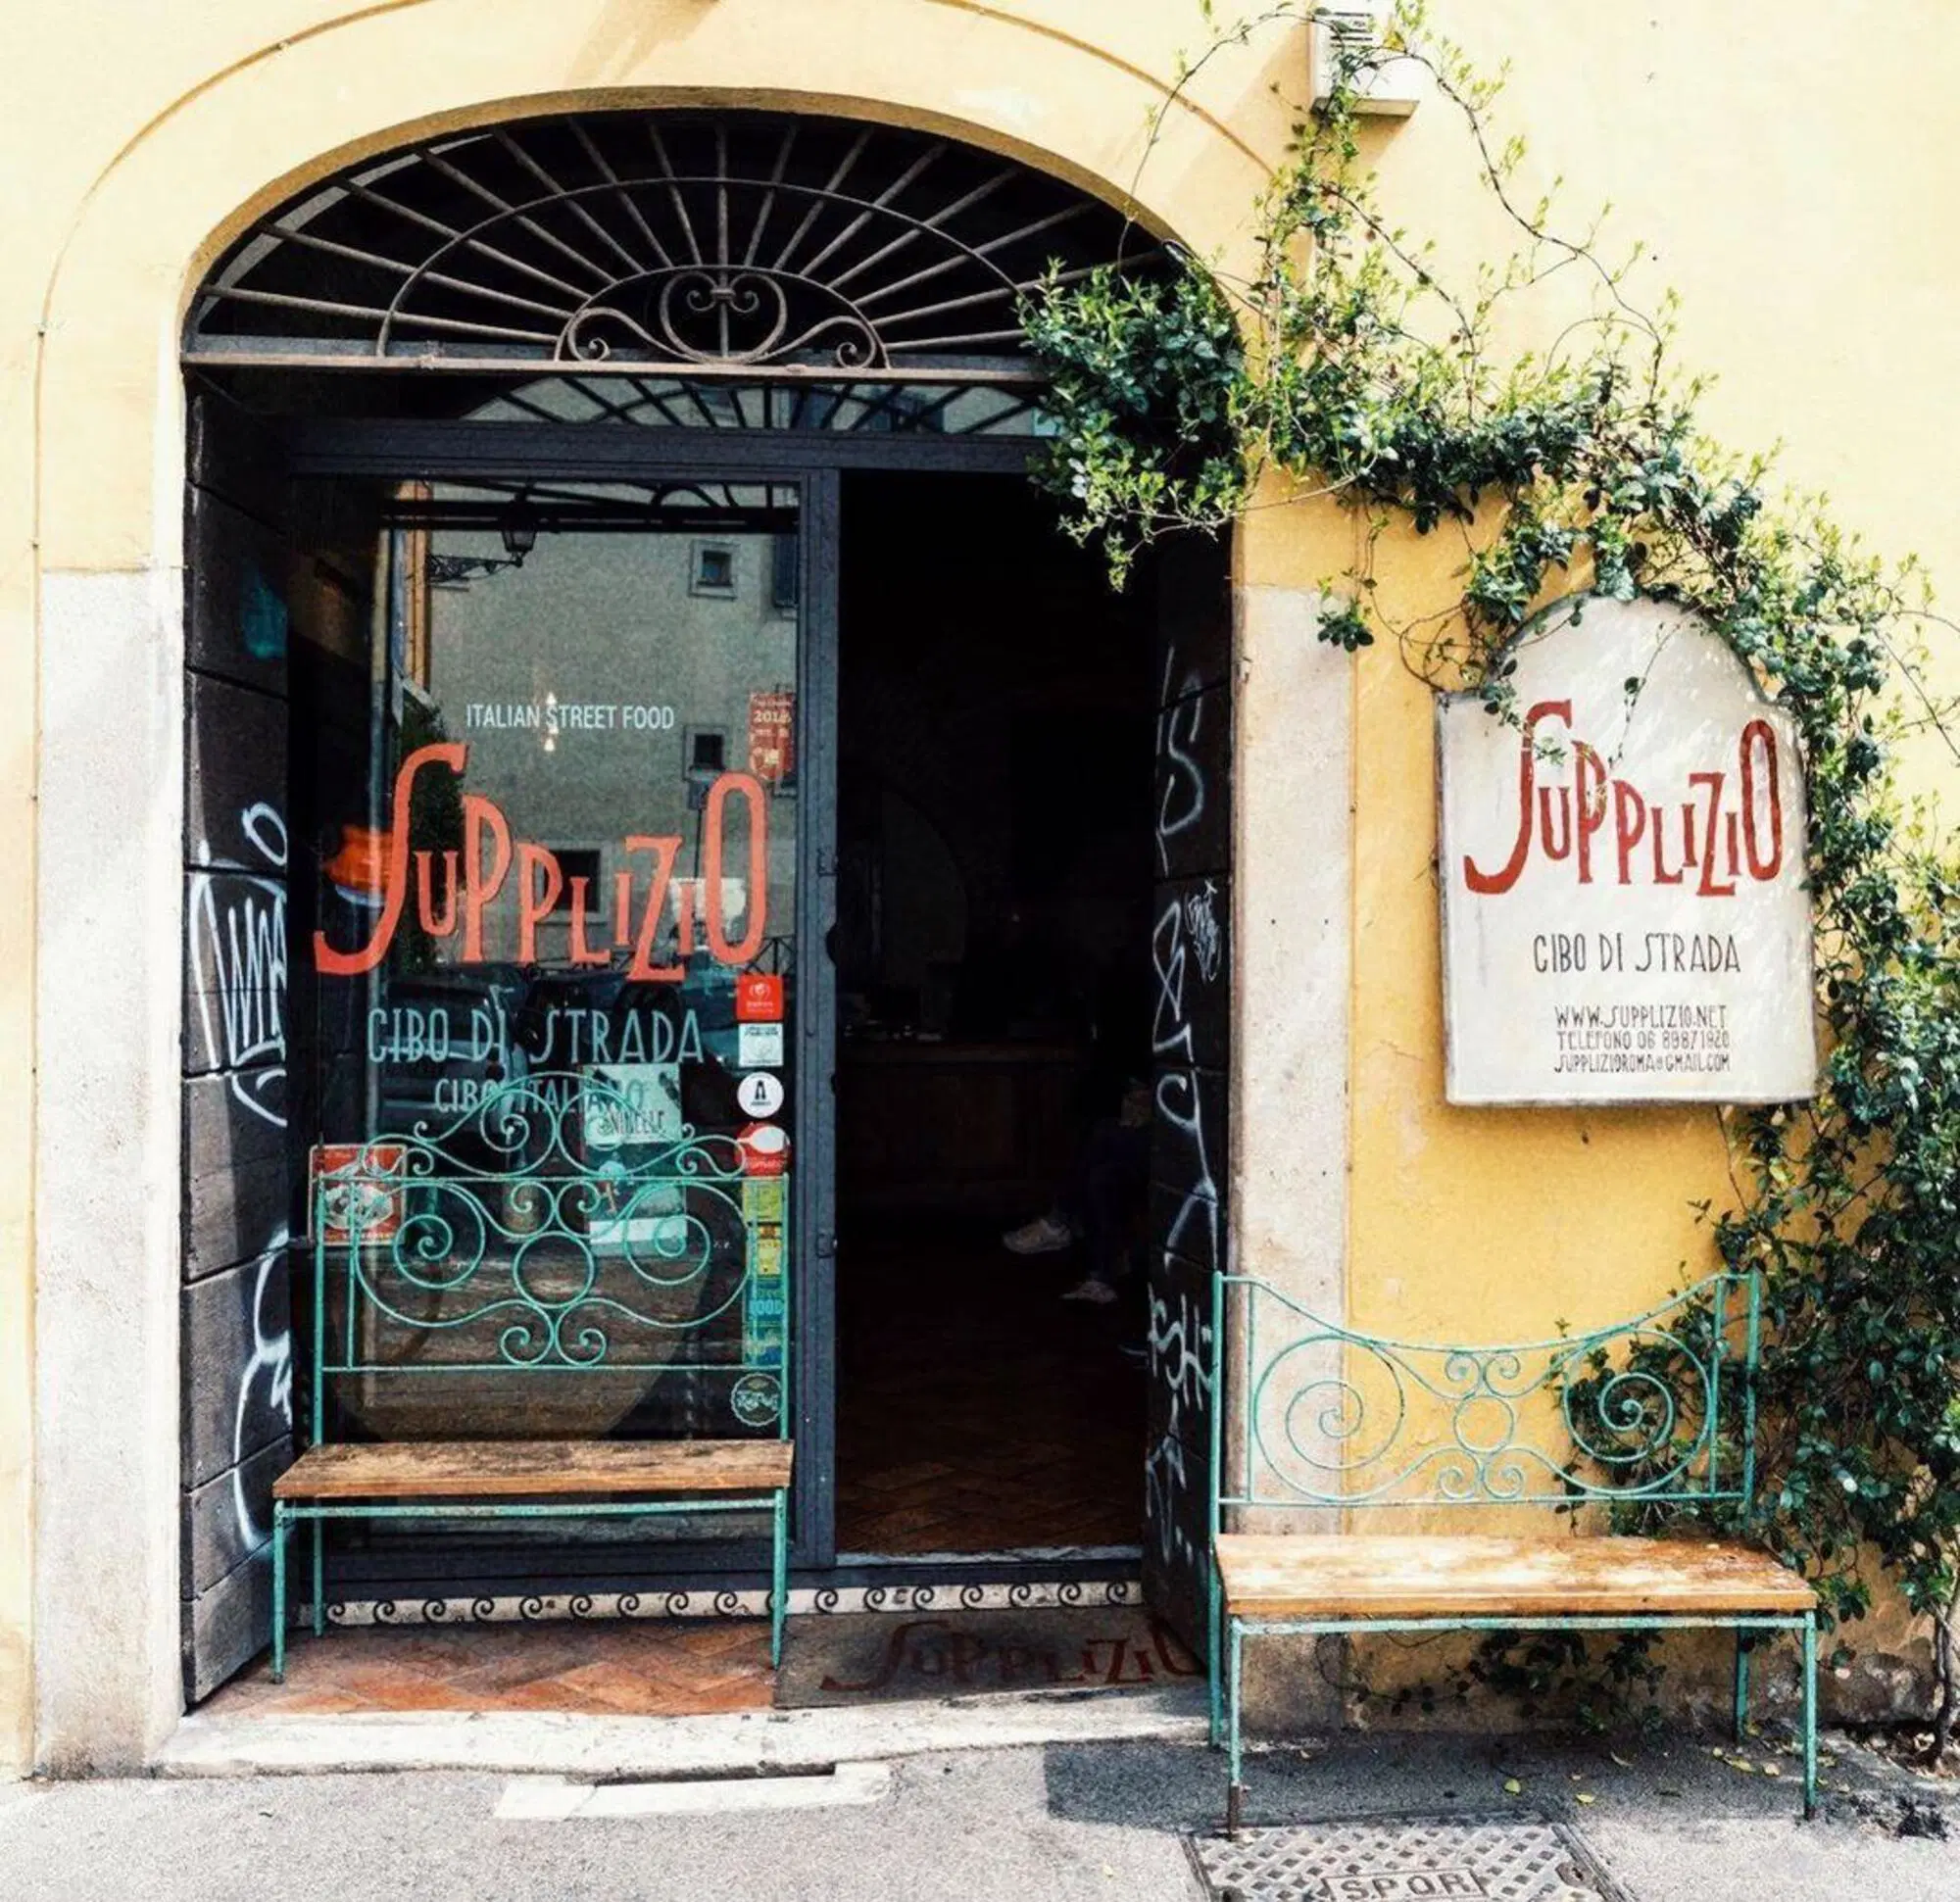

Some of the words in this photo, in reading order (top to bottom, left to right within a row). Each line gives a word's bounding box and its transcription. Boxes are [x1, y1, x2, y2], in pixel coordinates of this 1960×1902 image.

[466, 704, 539, 728] ITALIAN
[545, 704, 616, 729] STREET
[622, 705, 675, 729] FOOD
[1462, 699, 1784, 897] SUPPLIZIO
[314, 743, 766, 981] SUPPLIZIO
[1533, 932, 1587, 973] CIBO
[1599, 932, 1624, 973] DI
[1635, 931, 1742, 973] STRADA
[1554, 1004, 1728, 1029] WWW.SUPPLIZIO.NET
[367, 1007, 448, 1063] CIBO
[470, 1007, 507, 1063] DI
[528, 1008, 705, 1064] STRADA
[1556, 1031, 1633, 1051] TELEFONO
[1637, 1031, 1656, 1050] 06
[434, 1078, 499, 1114] CIBO
[1340, 1871, 1471, 1901] SPQR
